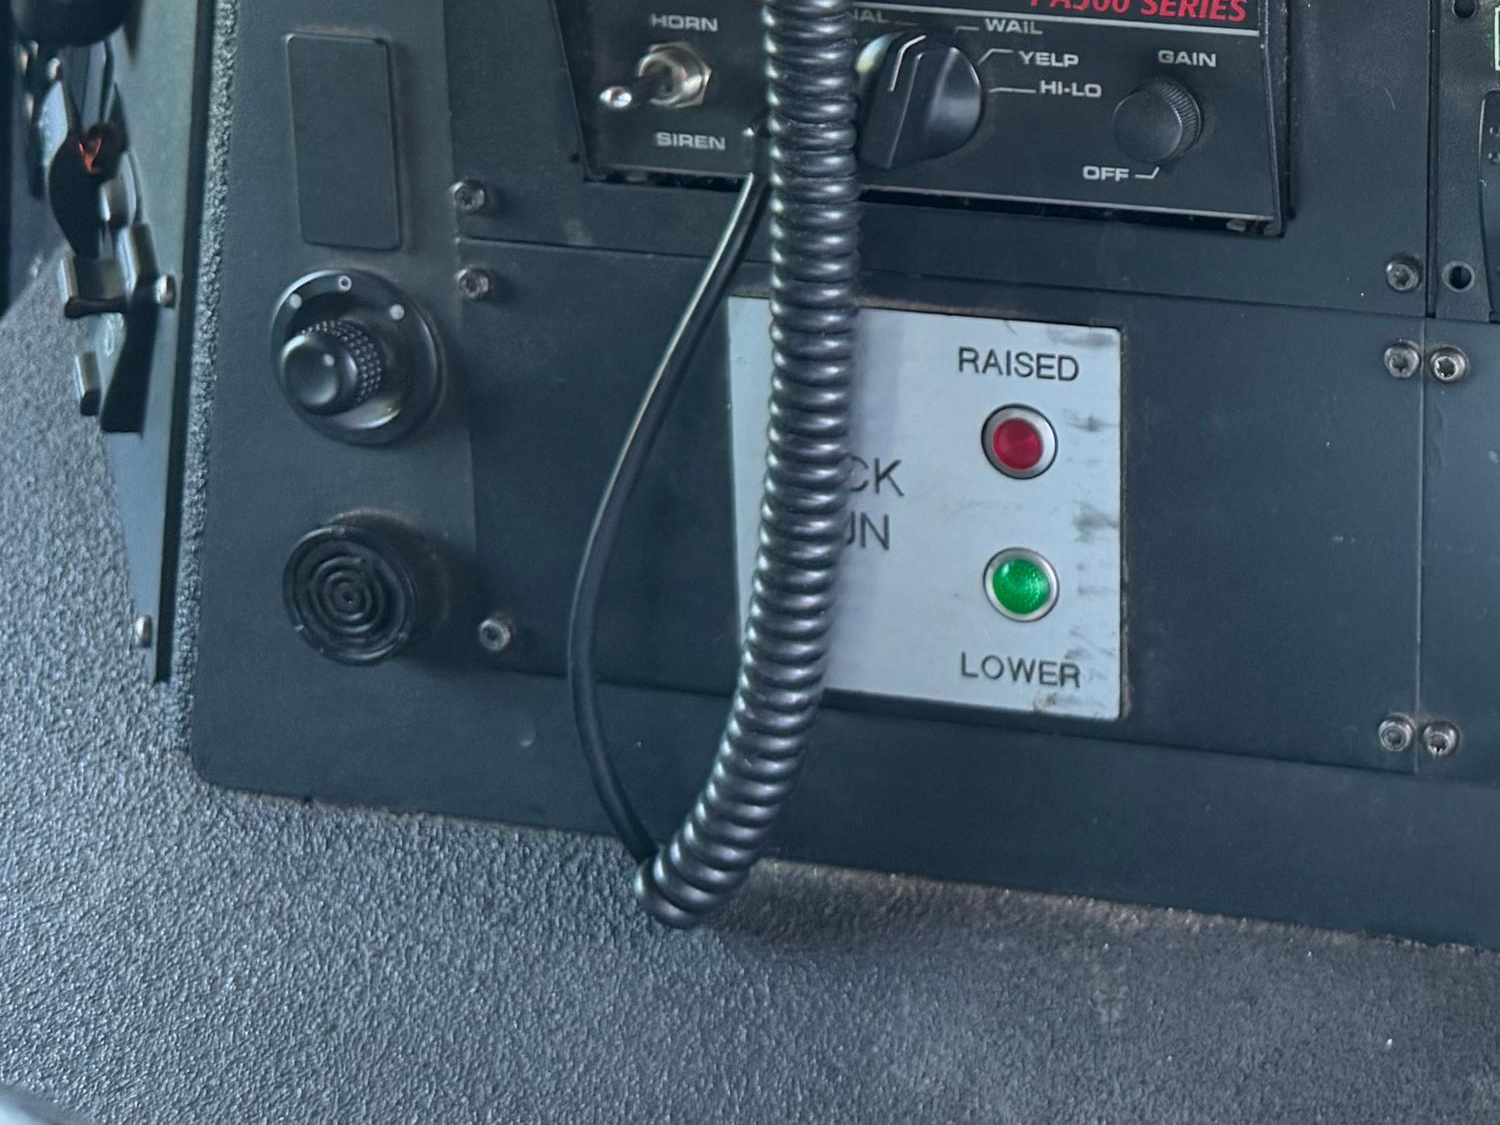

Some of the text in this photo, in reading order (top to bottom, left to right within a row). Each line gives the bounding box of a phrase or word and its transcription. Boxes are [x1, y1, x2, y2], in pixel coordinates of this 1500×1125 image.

[651, 13, 718, 32] HORN
[985, 18, 1044, 36] WAIL
[1018, 50, 1080, 68] YELP
[1158, 49, 1217, 68] GAIN
[1039, 80, 1103, 98] HI-LO
[656, 131, 726, 151] SIREN
[1083, 166, 1130, 182] OFF
[958, 346, 1079, 382] RAISED
[961, 651, 1081, 688] LOWER
